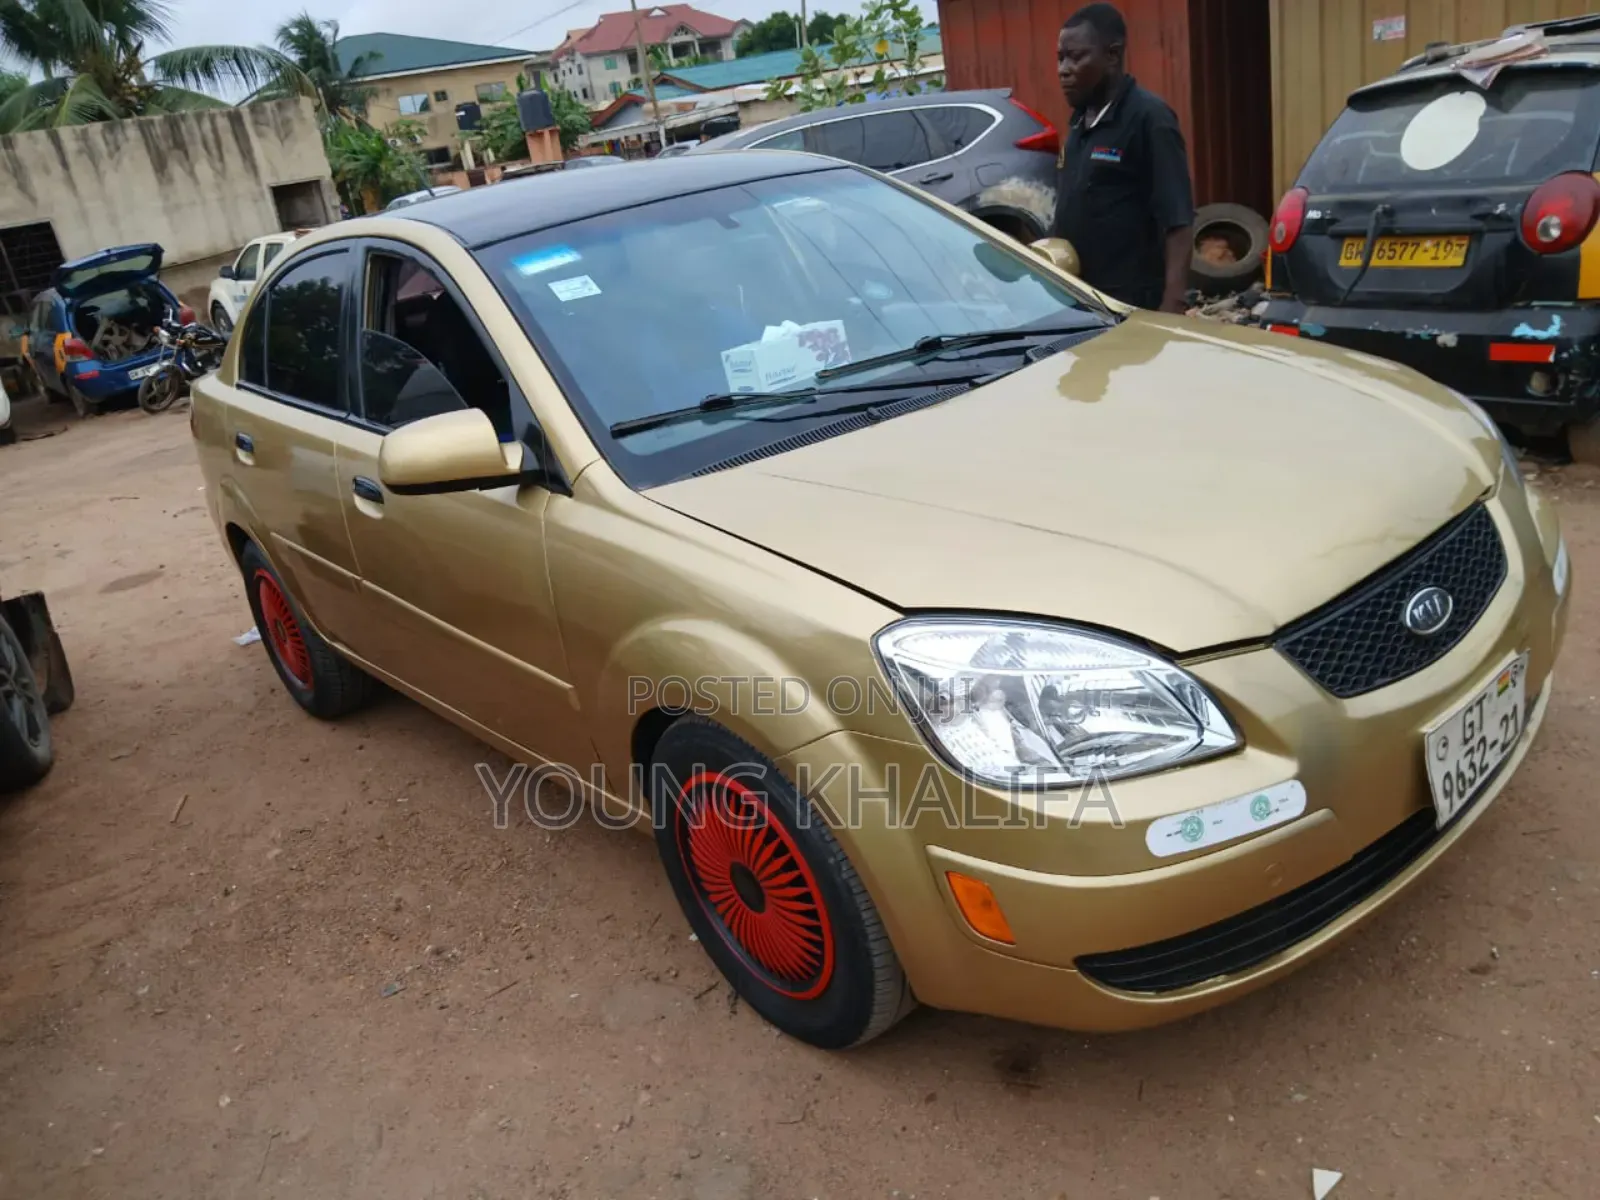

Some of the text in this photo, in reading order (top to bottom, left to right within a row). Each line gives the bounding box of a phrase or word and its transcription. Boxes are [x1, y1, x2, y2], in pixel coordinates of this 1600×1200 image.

[1376, 240, 1454, 261] 6577-19
[1462, 692, 1488, 746] GT
[1442, 703, 1518, 813] 9632-21
